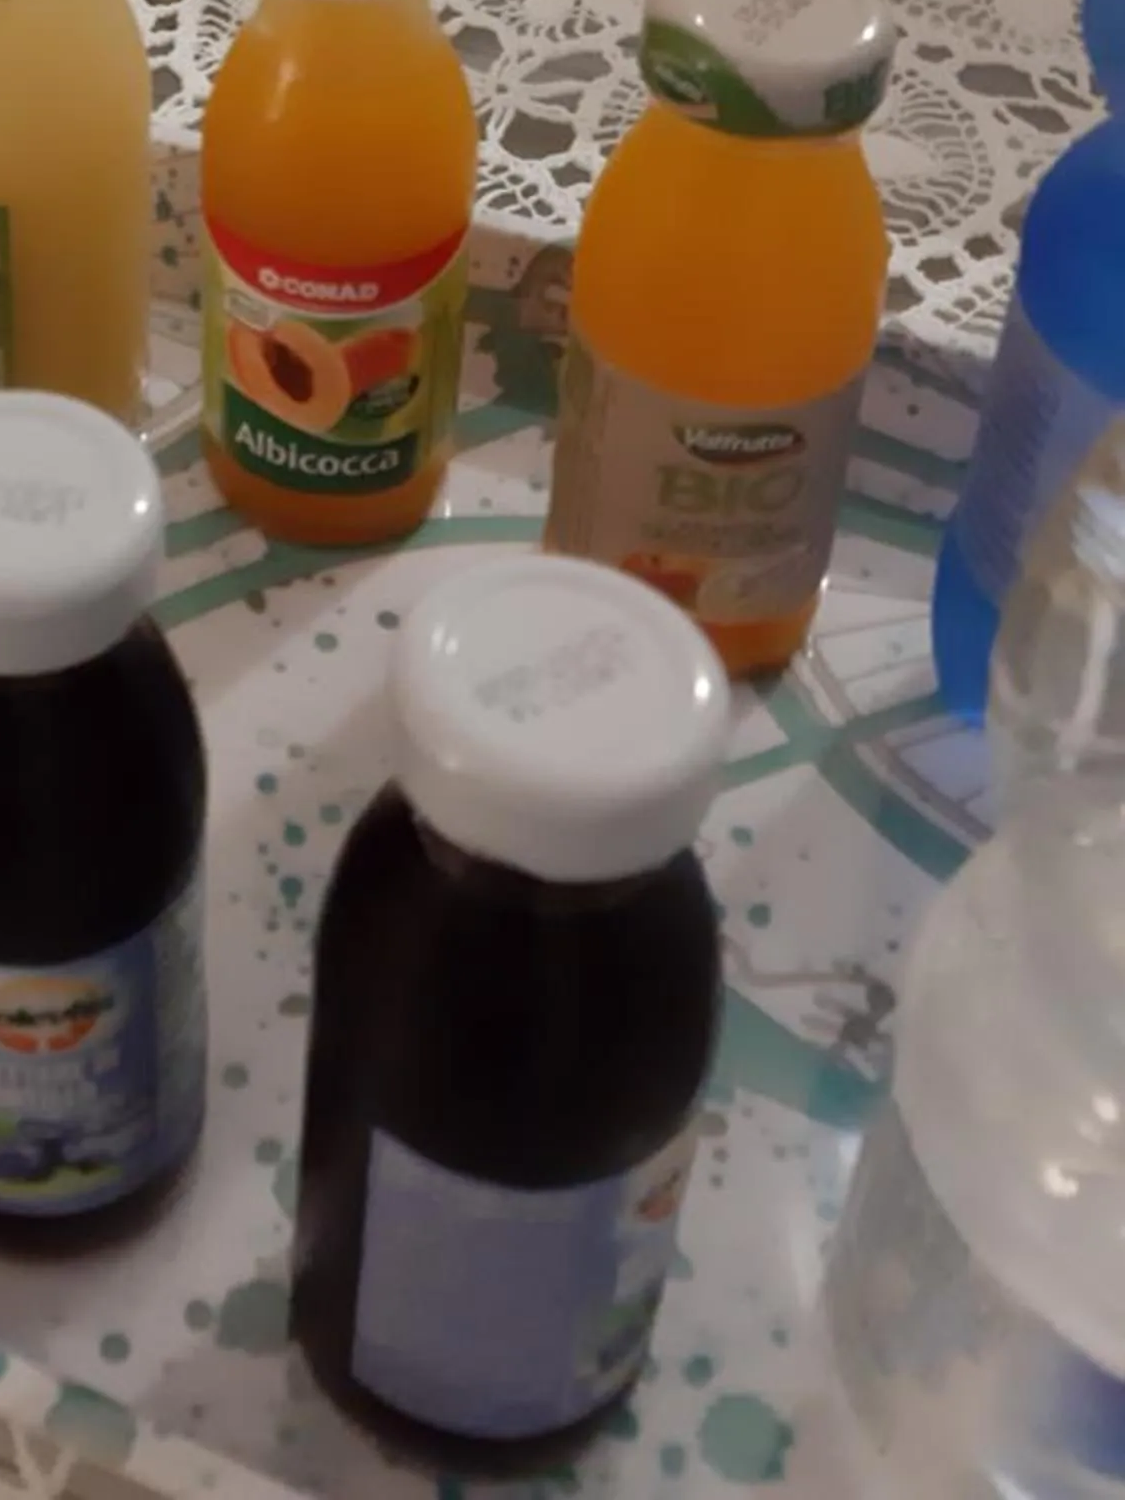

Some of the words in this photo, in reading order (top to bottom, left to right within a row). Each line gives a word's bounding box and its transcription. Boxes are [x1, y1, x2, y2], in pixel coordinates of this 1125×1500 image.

[281, 276, 379, 301] CONAD
[234, 420, 401, 477] Albicocca
[656, 464, 807, 515] BIO
